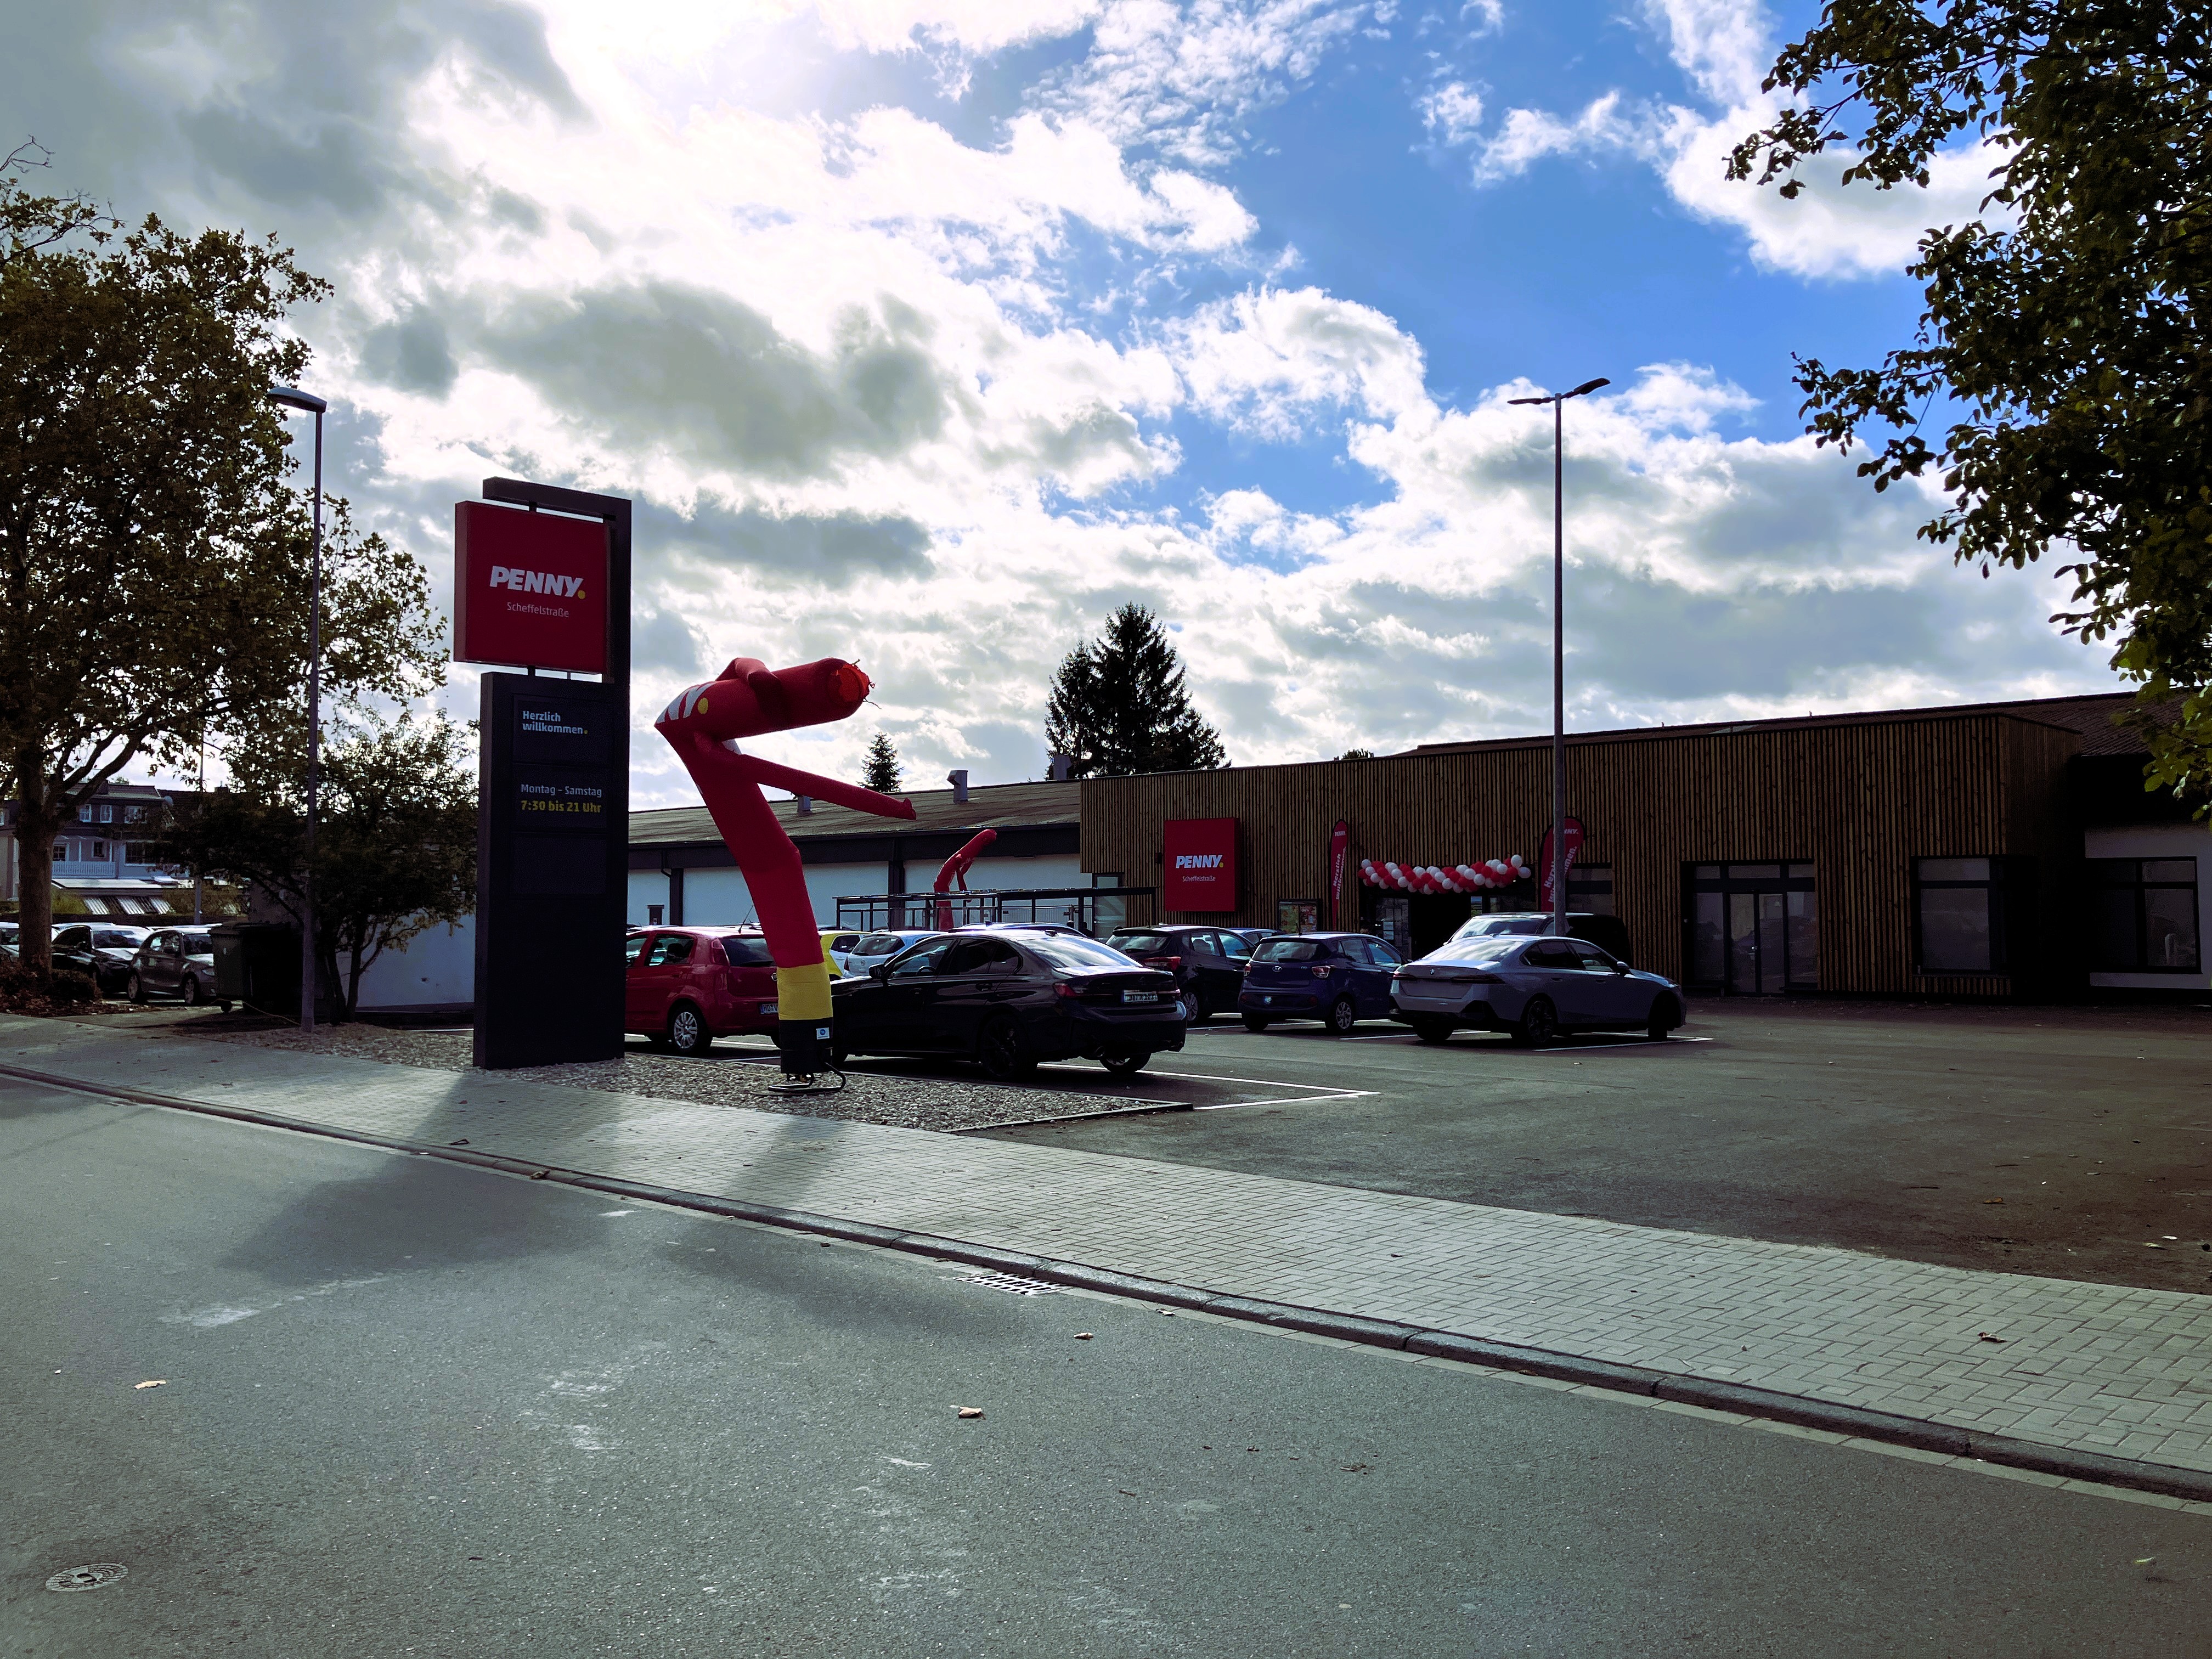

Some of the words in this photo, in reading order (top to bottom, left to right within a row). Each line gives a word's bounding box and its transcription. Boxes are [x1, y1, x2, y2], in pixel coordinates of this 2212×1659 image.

[506, 602, 569, 618] Scheffelstraße
[522, 710, 561, 722] Herzlich
[522, 721, 588, 735] willkommen.
[521, 784, 556, 796] Montag
[565, 786, 602, 798] Samstag
[521, 800, 545, 810] 7:30
[549, 800, 565, 811] bis
[567, 802, 579, 812] 21
[583, 802, 601, 813] Uhr
